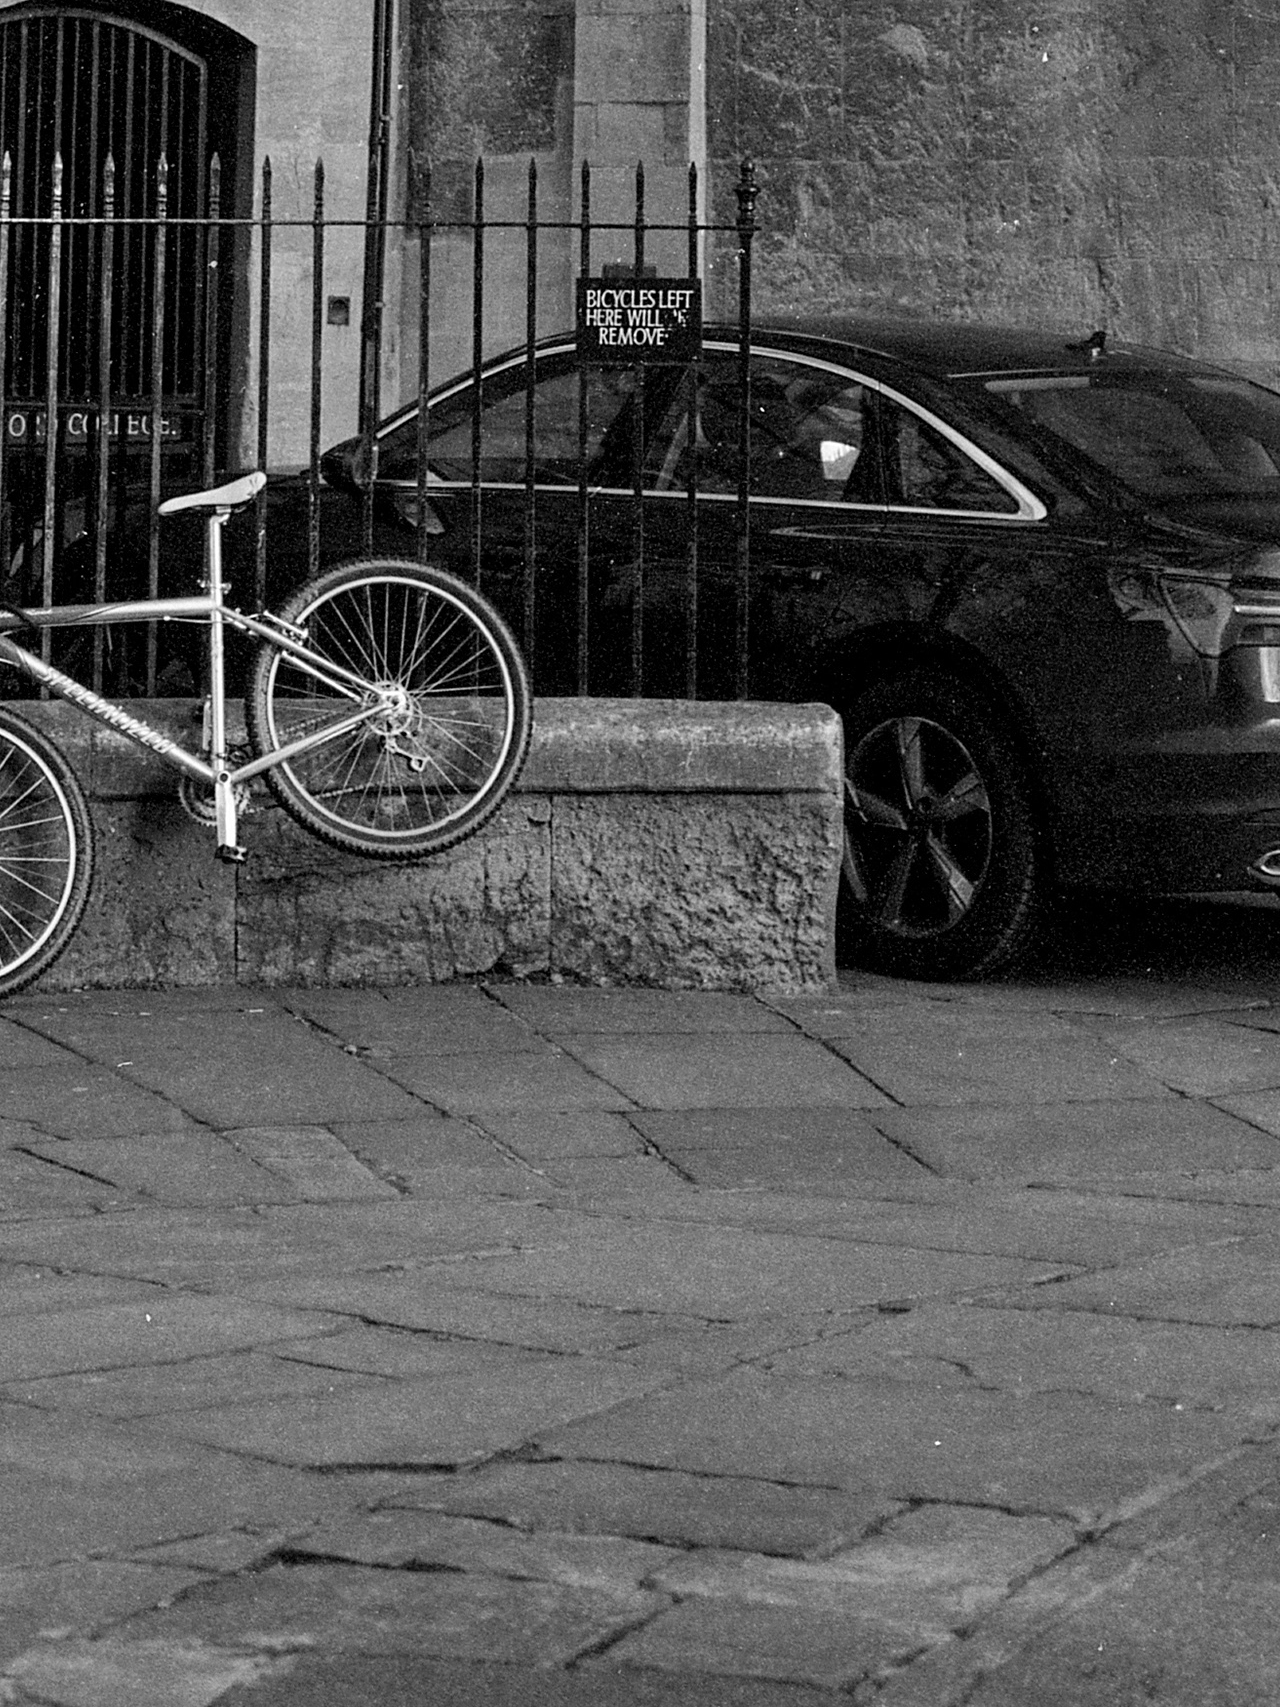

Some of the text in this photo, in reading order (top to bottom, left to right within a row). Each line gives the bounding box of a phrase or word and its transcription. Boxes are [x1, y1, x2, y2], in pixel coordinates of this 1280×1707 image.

[586, 289, 694, 308] BICYCLES LEFT
[586, 309, 622, 327] HERE
[627, 309, 664, 327] WILL
[599, 327, 669, 345] REMOVE
